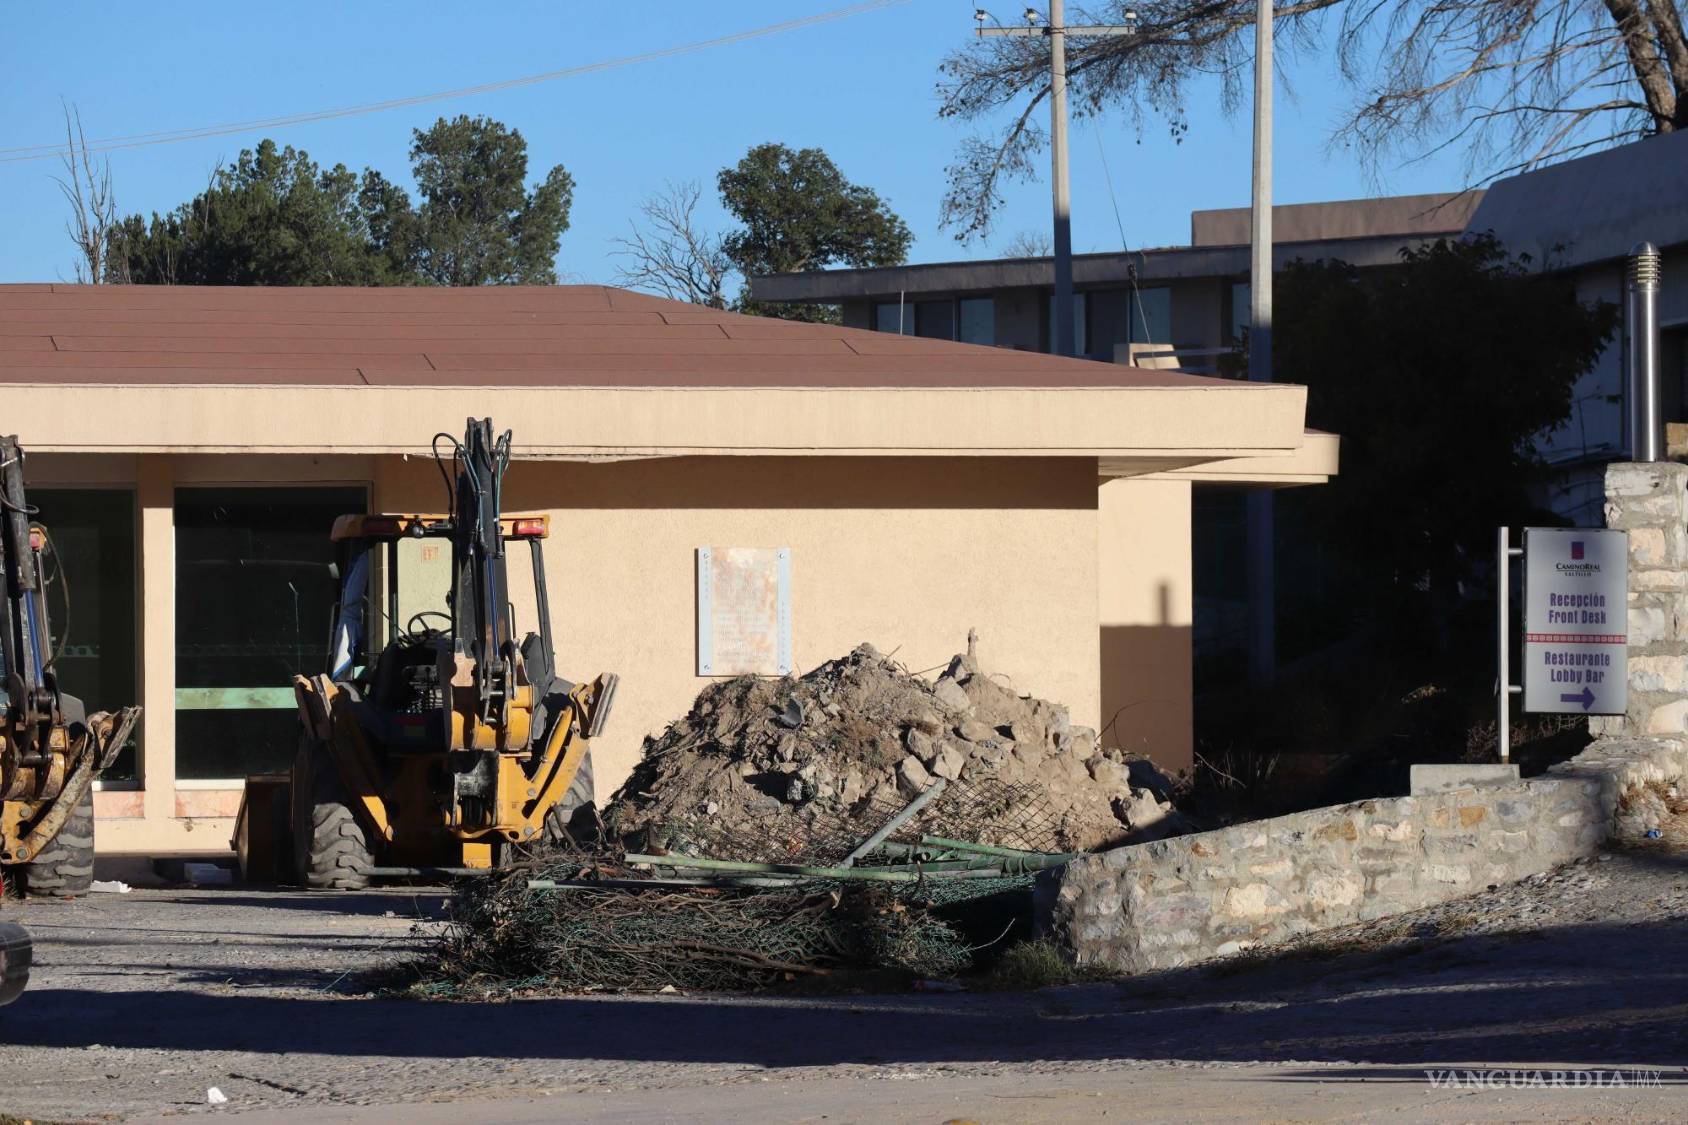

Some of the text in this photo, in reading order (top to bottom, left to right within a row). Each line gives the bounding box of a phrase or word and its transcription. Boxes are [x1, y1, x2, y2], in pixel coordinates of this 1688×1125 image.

[1550, 592, 1606, 608] Recepción
[1549, 610, 1607, 624] Front Desk
[1544, 651, 1611, 666] Restaurante
[1550, 669, 1605, 684] Lobby Bar
